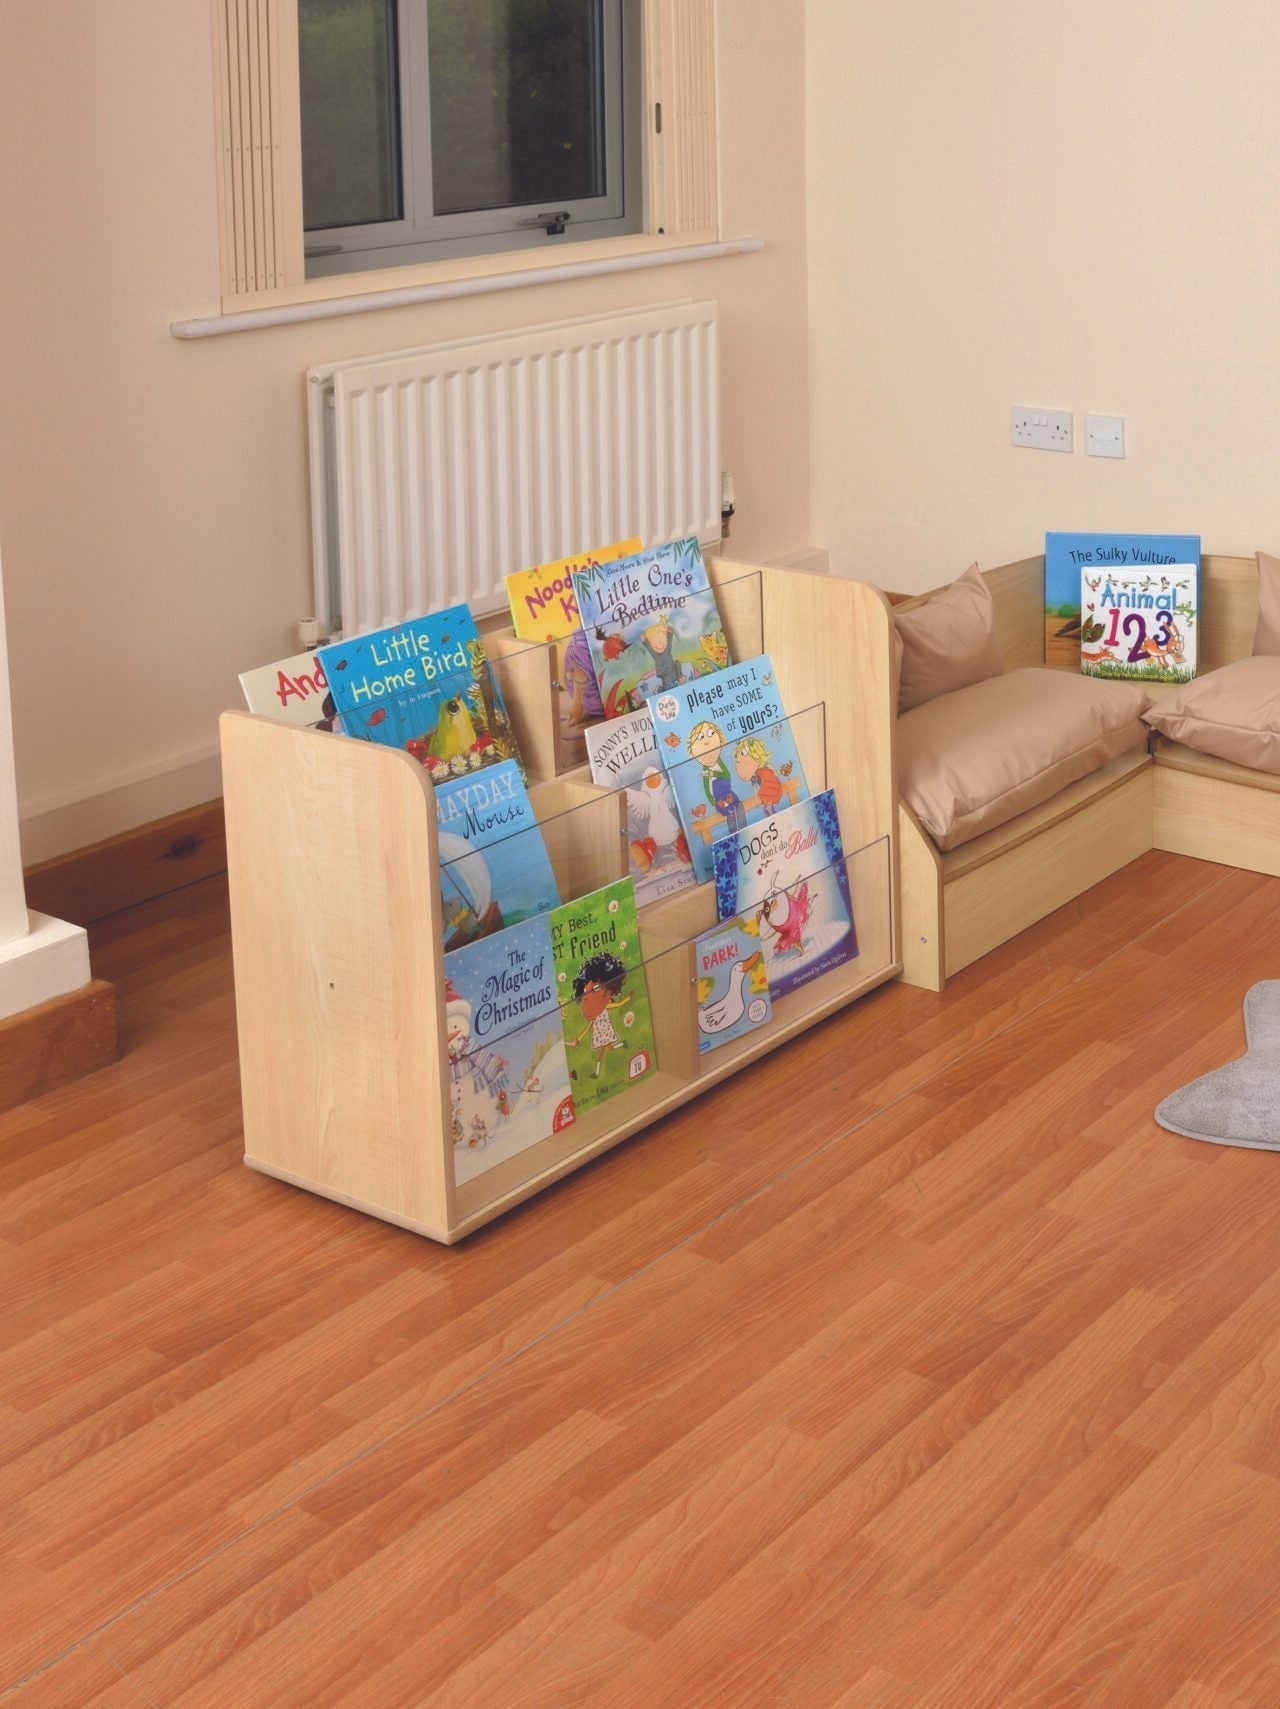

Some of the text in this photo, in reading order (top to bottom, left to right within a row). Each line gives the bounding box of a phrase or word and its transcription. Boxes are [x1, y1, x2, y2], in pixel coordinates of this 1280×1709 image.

[1069, 547, 1176, 565] The Sulky Vulture
[594, 564, 693, 614] Little One's
[1100, 584, 1177, 610] Animal
[611, 593, 686, 629] Bedtime
[371, 629, 430, 666] Little
[350, 641, 467, 703] Home Bird
[687, 667, 757, 713] please may I
[711, 687, 763, 720] have SOME
[726, 704, 779, 734] of yours?
[594, 726, 629, 768] SONNY'S
[462, 805, 524, 840] Mouse
[740, 822, 779, 865] DOGS
[760, 843, 778, 860] don't
[779, 840, 788, 852] do
[507, 949, 526, 966] The
[702, 942, 739, 971] PARK!
[482, 956, 544, 1002] Magic of
[474, 986, 551, 1036] Christmas
